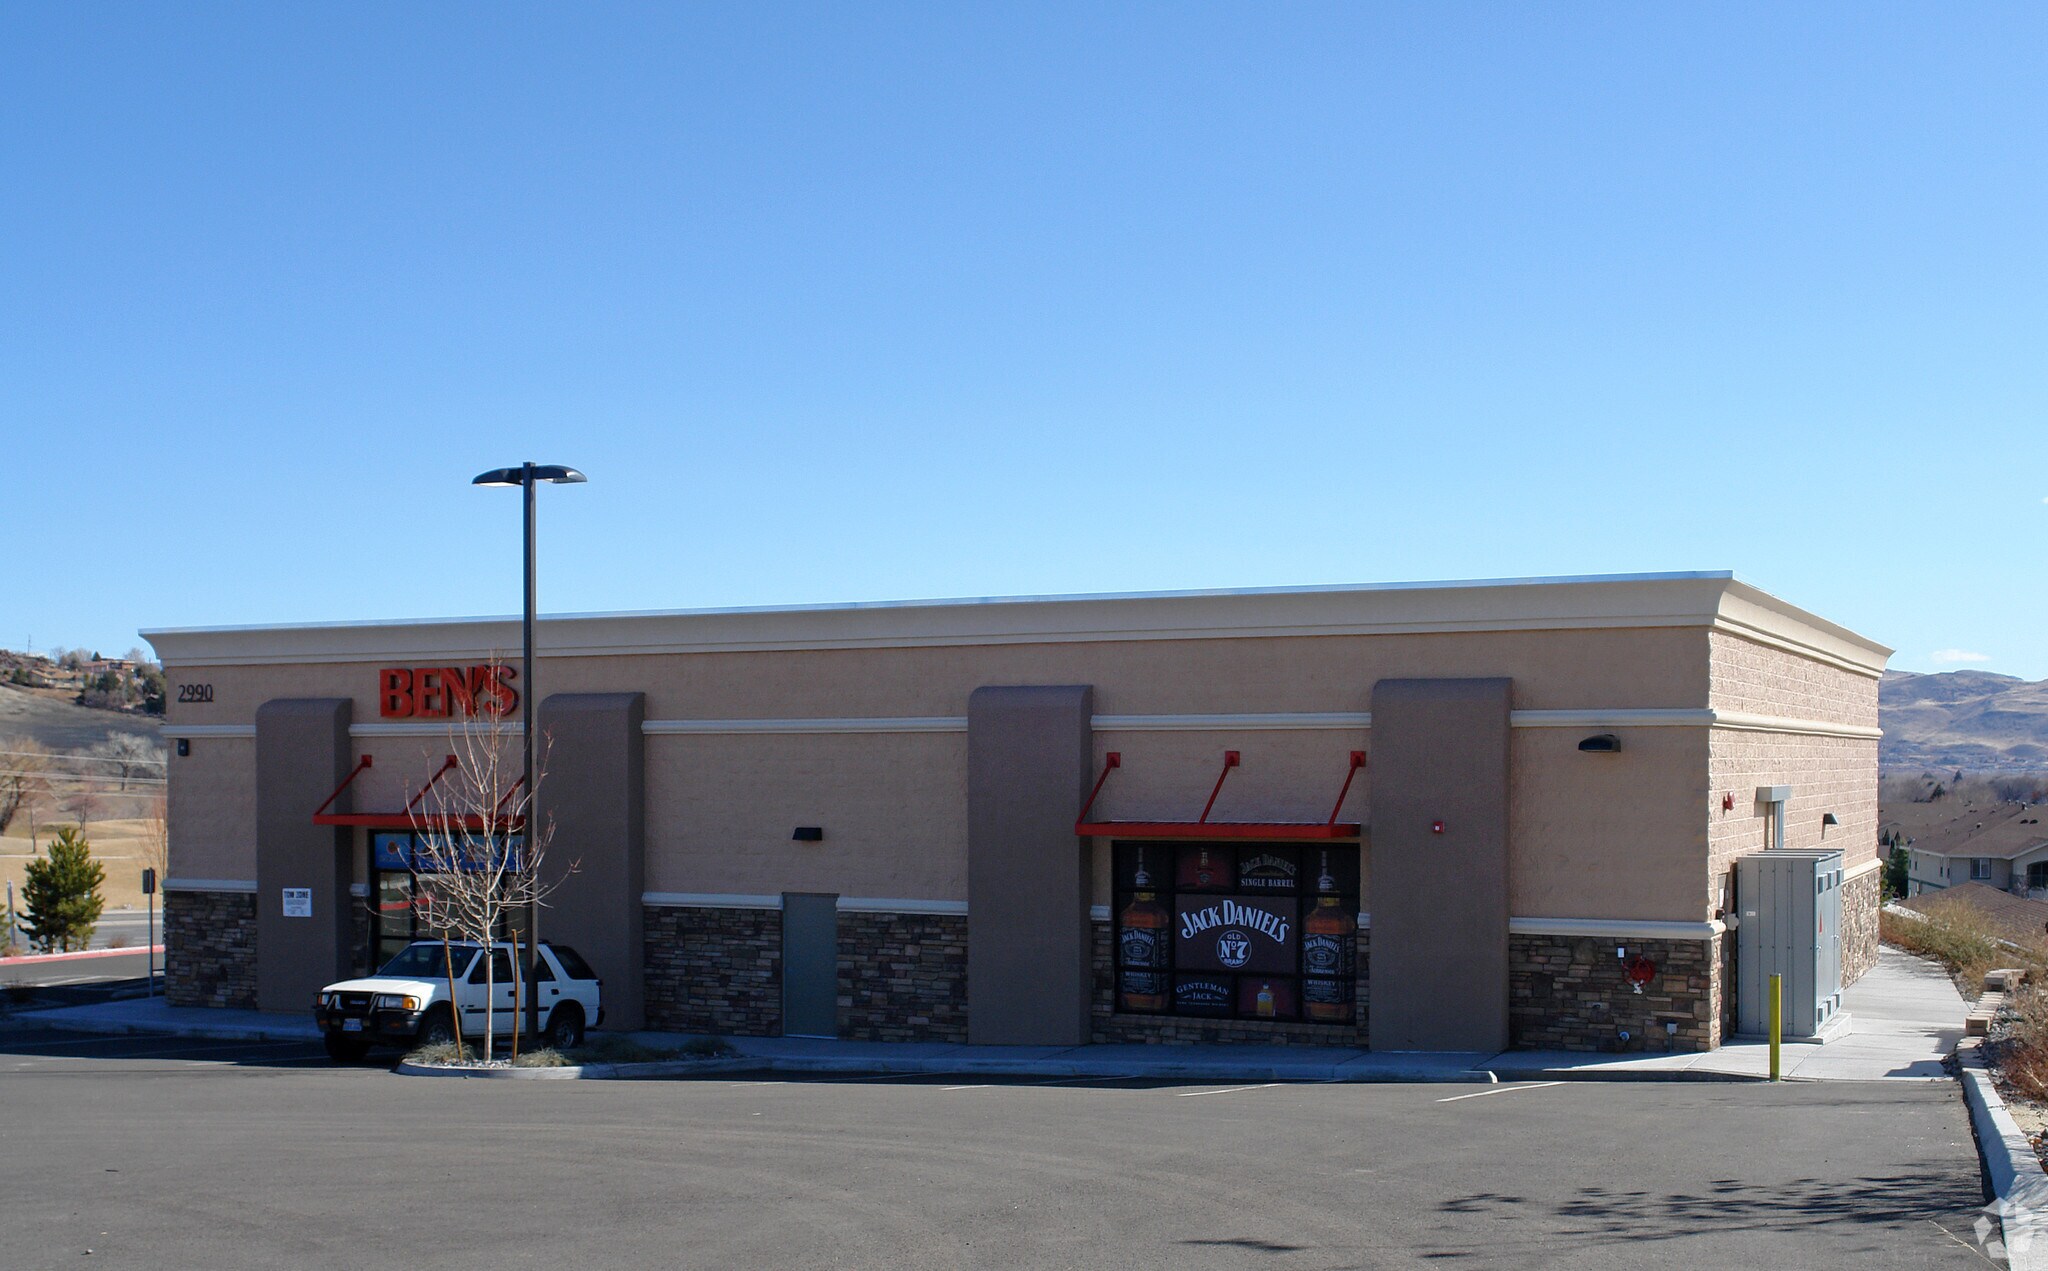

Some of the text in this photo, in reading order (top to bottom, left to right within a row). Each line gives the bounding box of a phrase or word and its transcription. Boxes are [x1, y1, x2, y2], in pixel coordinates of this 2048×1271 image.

[178, 684, 214, 703] 2990
[379, 664, 519, 718] BEN'S
[1240, 878, 1295, 888] SINGLE BARREL
[1181, 899, 1290, 943] JACK DANIEL'S
[1176, 982, 1229, 995] GENTLEMAN
[1192, 991, 1212, 1000] JACK
